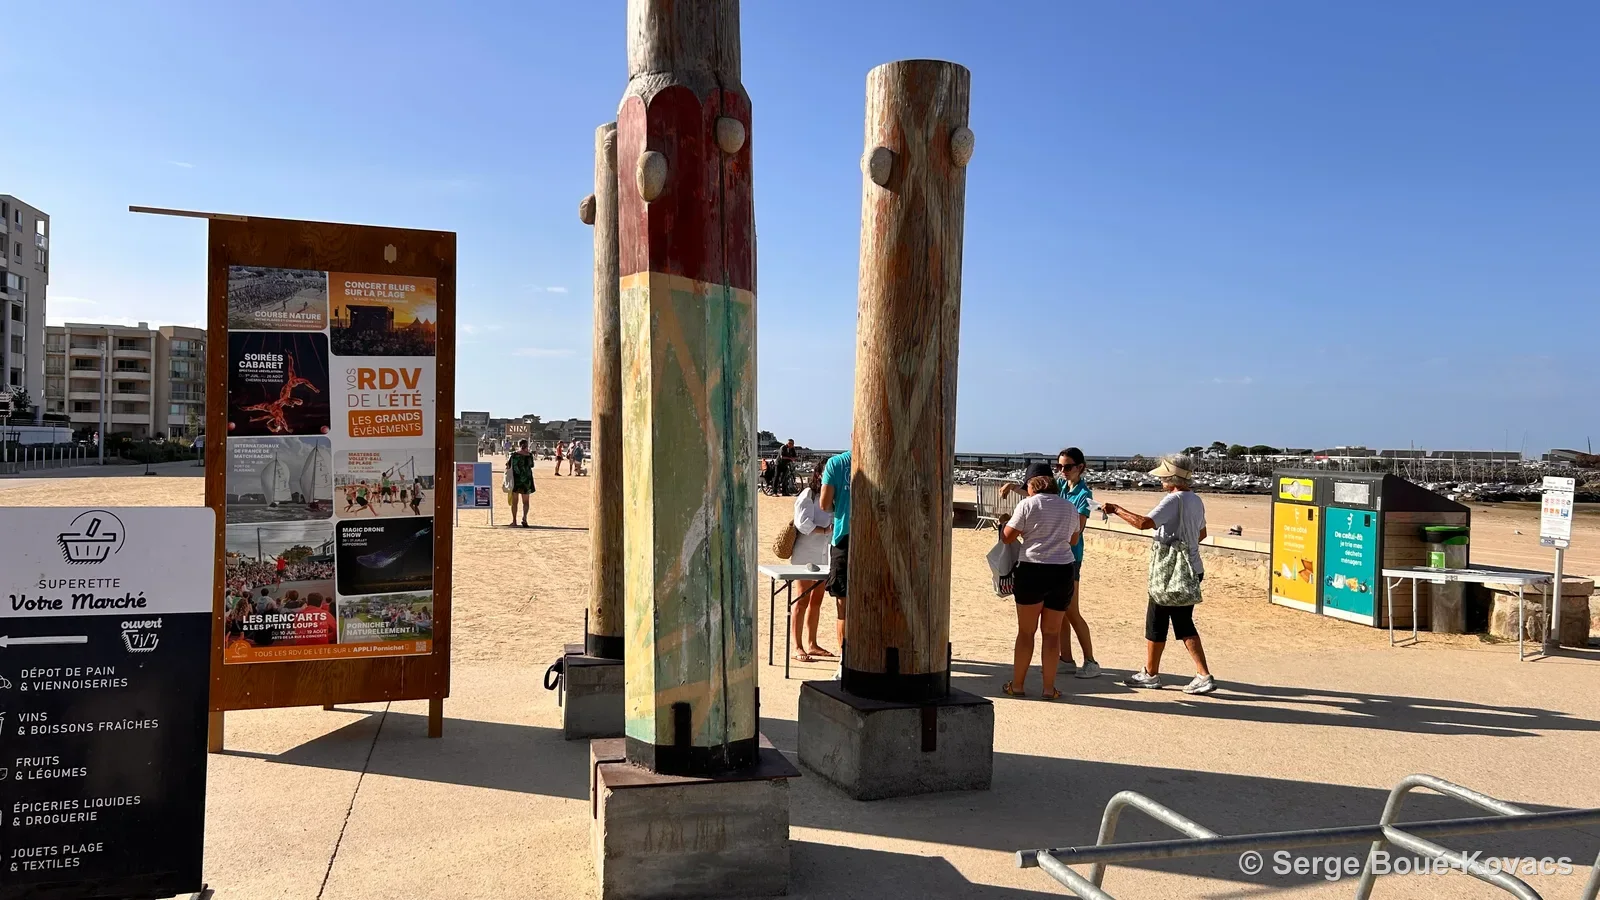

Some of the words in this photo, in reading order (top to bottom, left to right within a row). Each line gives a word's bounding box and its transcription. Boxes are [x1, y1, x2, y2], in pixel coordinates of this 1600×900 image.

[345, 281, 387, 290] CONCERT
[255, 311, 288, 319] COURSE
[244, 352, 283, 361] SOIRÉES
[239, 361, 283, 369] CABARET
[346, 368, 356, 390] VOS
[358, 368, 422, 390] RDV
[348, 394, 370, 408] DE
[378, 390, 422, 407] L'ÉTÉ
[352, 415, 371, 426] LES
[375, 413, 420, 424] GRANDS
[353, 422, 421, 436] ÉVÉNEMENTS
[1345, 550, 1362, 558] déchets
[1341, 558, 1362, 566] ménagers
[38, 578, 120, 589] SUPERETTE
[10, 594, 63, 611] Votre
[72, 591, 147, 610] Marché
[121, 618, 162, 629] ouvert
[242, 615, 262, 624] LES
[263, 612, 327, 623] RENC'ARTS
[347, 627, 410, 636] NATURELLEMENT
[132, 633, 156, 648] 7j/7
[22, 667, 61, 678] DÉPOT
[66, 668, 81, 677] DE
[86, 666, 115, 676] PAIN
[20, 682, 28, 691] &
[33, 678, 128, 690] VIENNOISERIES
[18, 712, 48, 722] VINS
[18, 726, 26, 736] &
[31, 723, 94, 735] BOISSONS
[98, 719, 159, 731] FRAÎCHES
[16, 756, 60, 767] FRUITS
[15, 771, 23, 780] &
[28, 767, 87, 779] LÉGUMES
[14, 799, 79, 813] ÉPICERIES
[84, 796, 141, 808] LIQUIDES
[13, 817, 20, 826] &
[26, 811, 97, 825] DROGUERIE
[11, 846, 58, 858] JOUETS
[63, 842, 104, 854] PLAGE
[10, 862, 18, 872] &
[23, 858, 80, 870] TEXTILES
